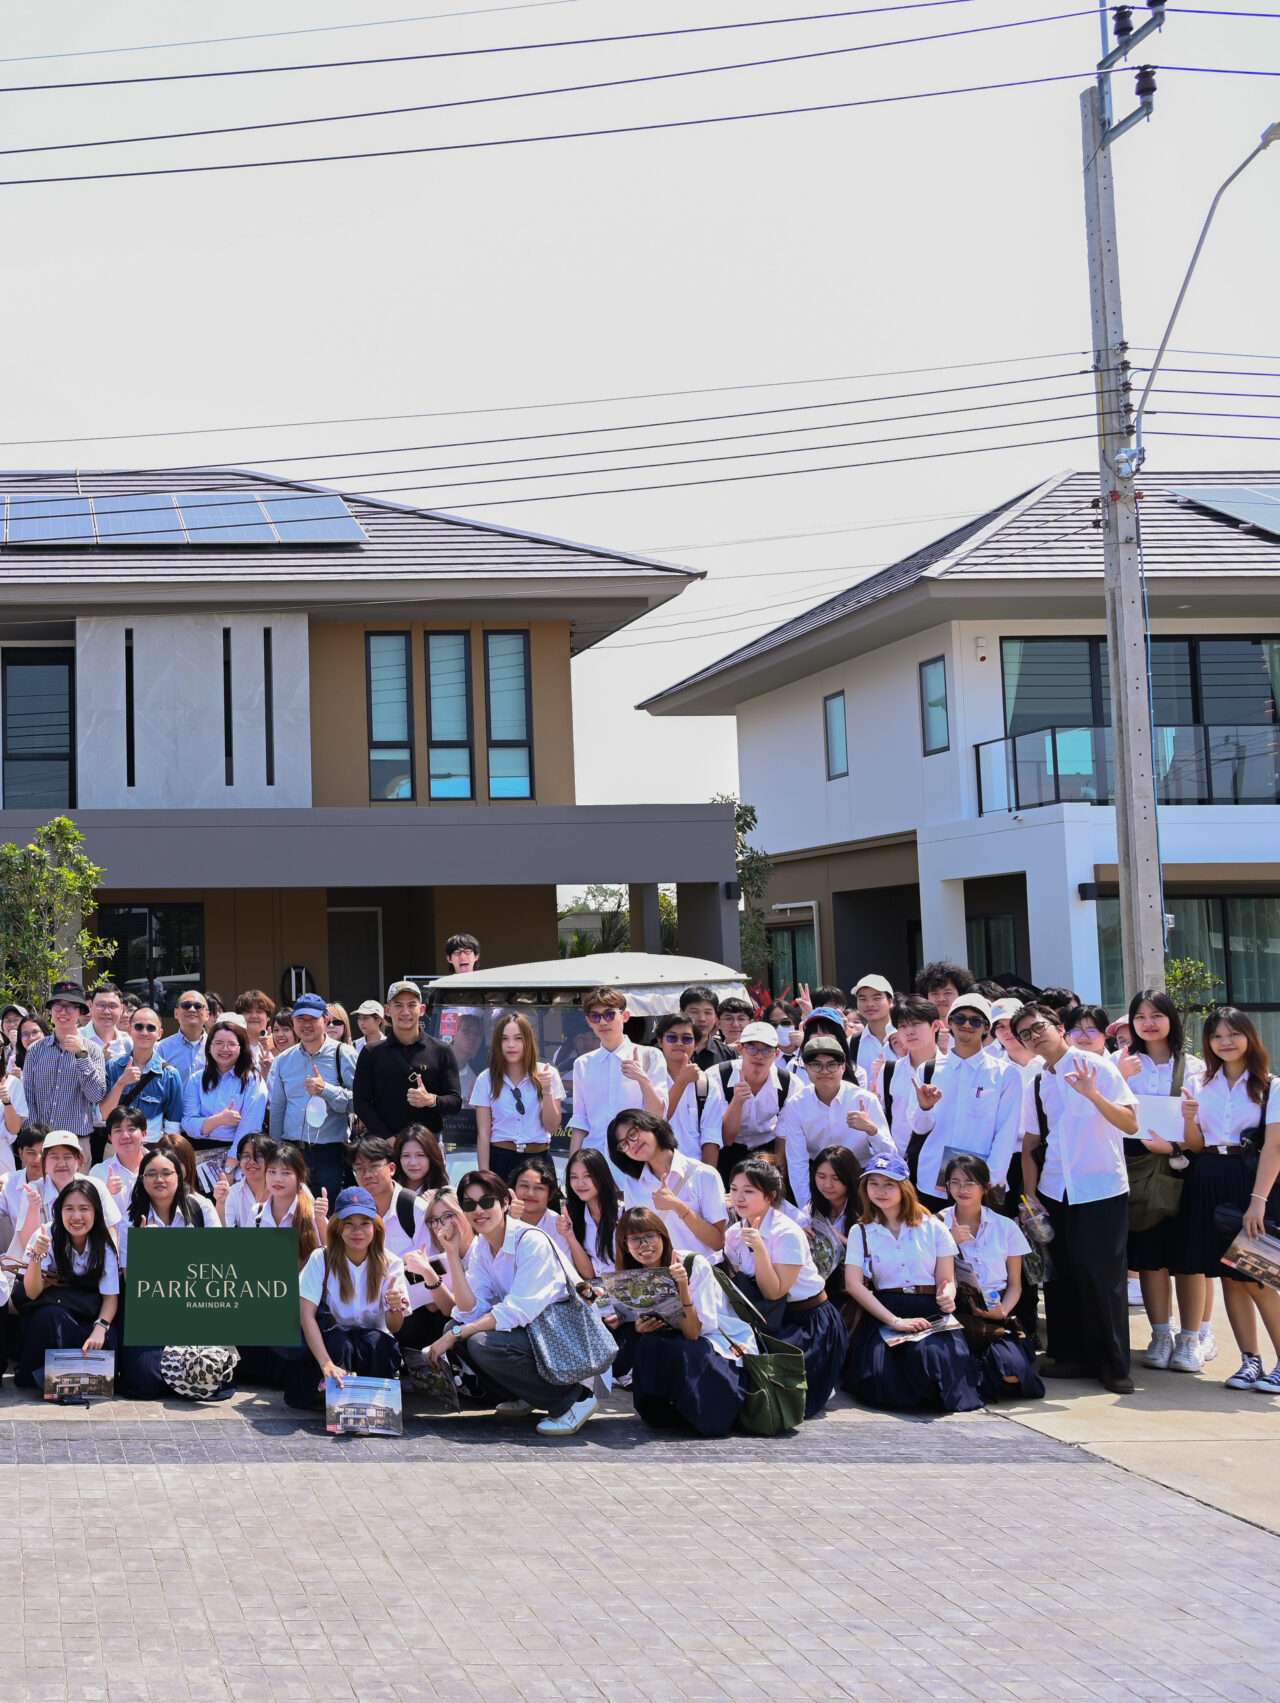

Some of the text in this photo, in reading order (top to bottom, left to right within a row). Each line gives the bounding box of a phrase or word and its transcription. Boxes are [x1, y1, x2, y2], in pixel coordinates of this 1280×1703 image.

[186, 1263, 238, 1280] SENA
[137, 1280, 288, 1299] PARK GRAND
[186, 1301, 240, 1309] RAMINDRA 2
